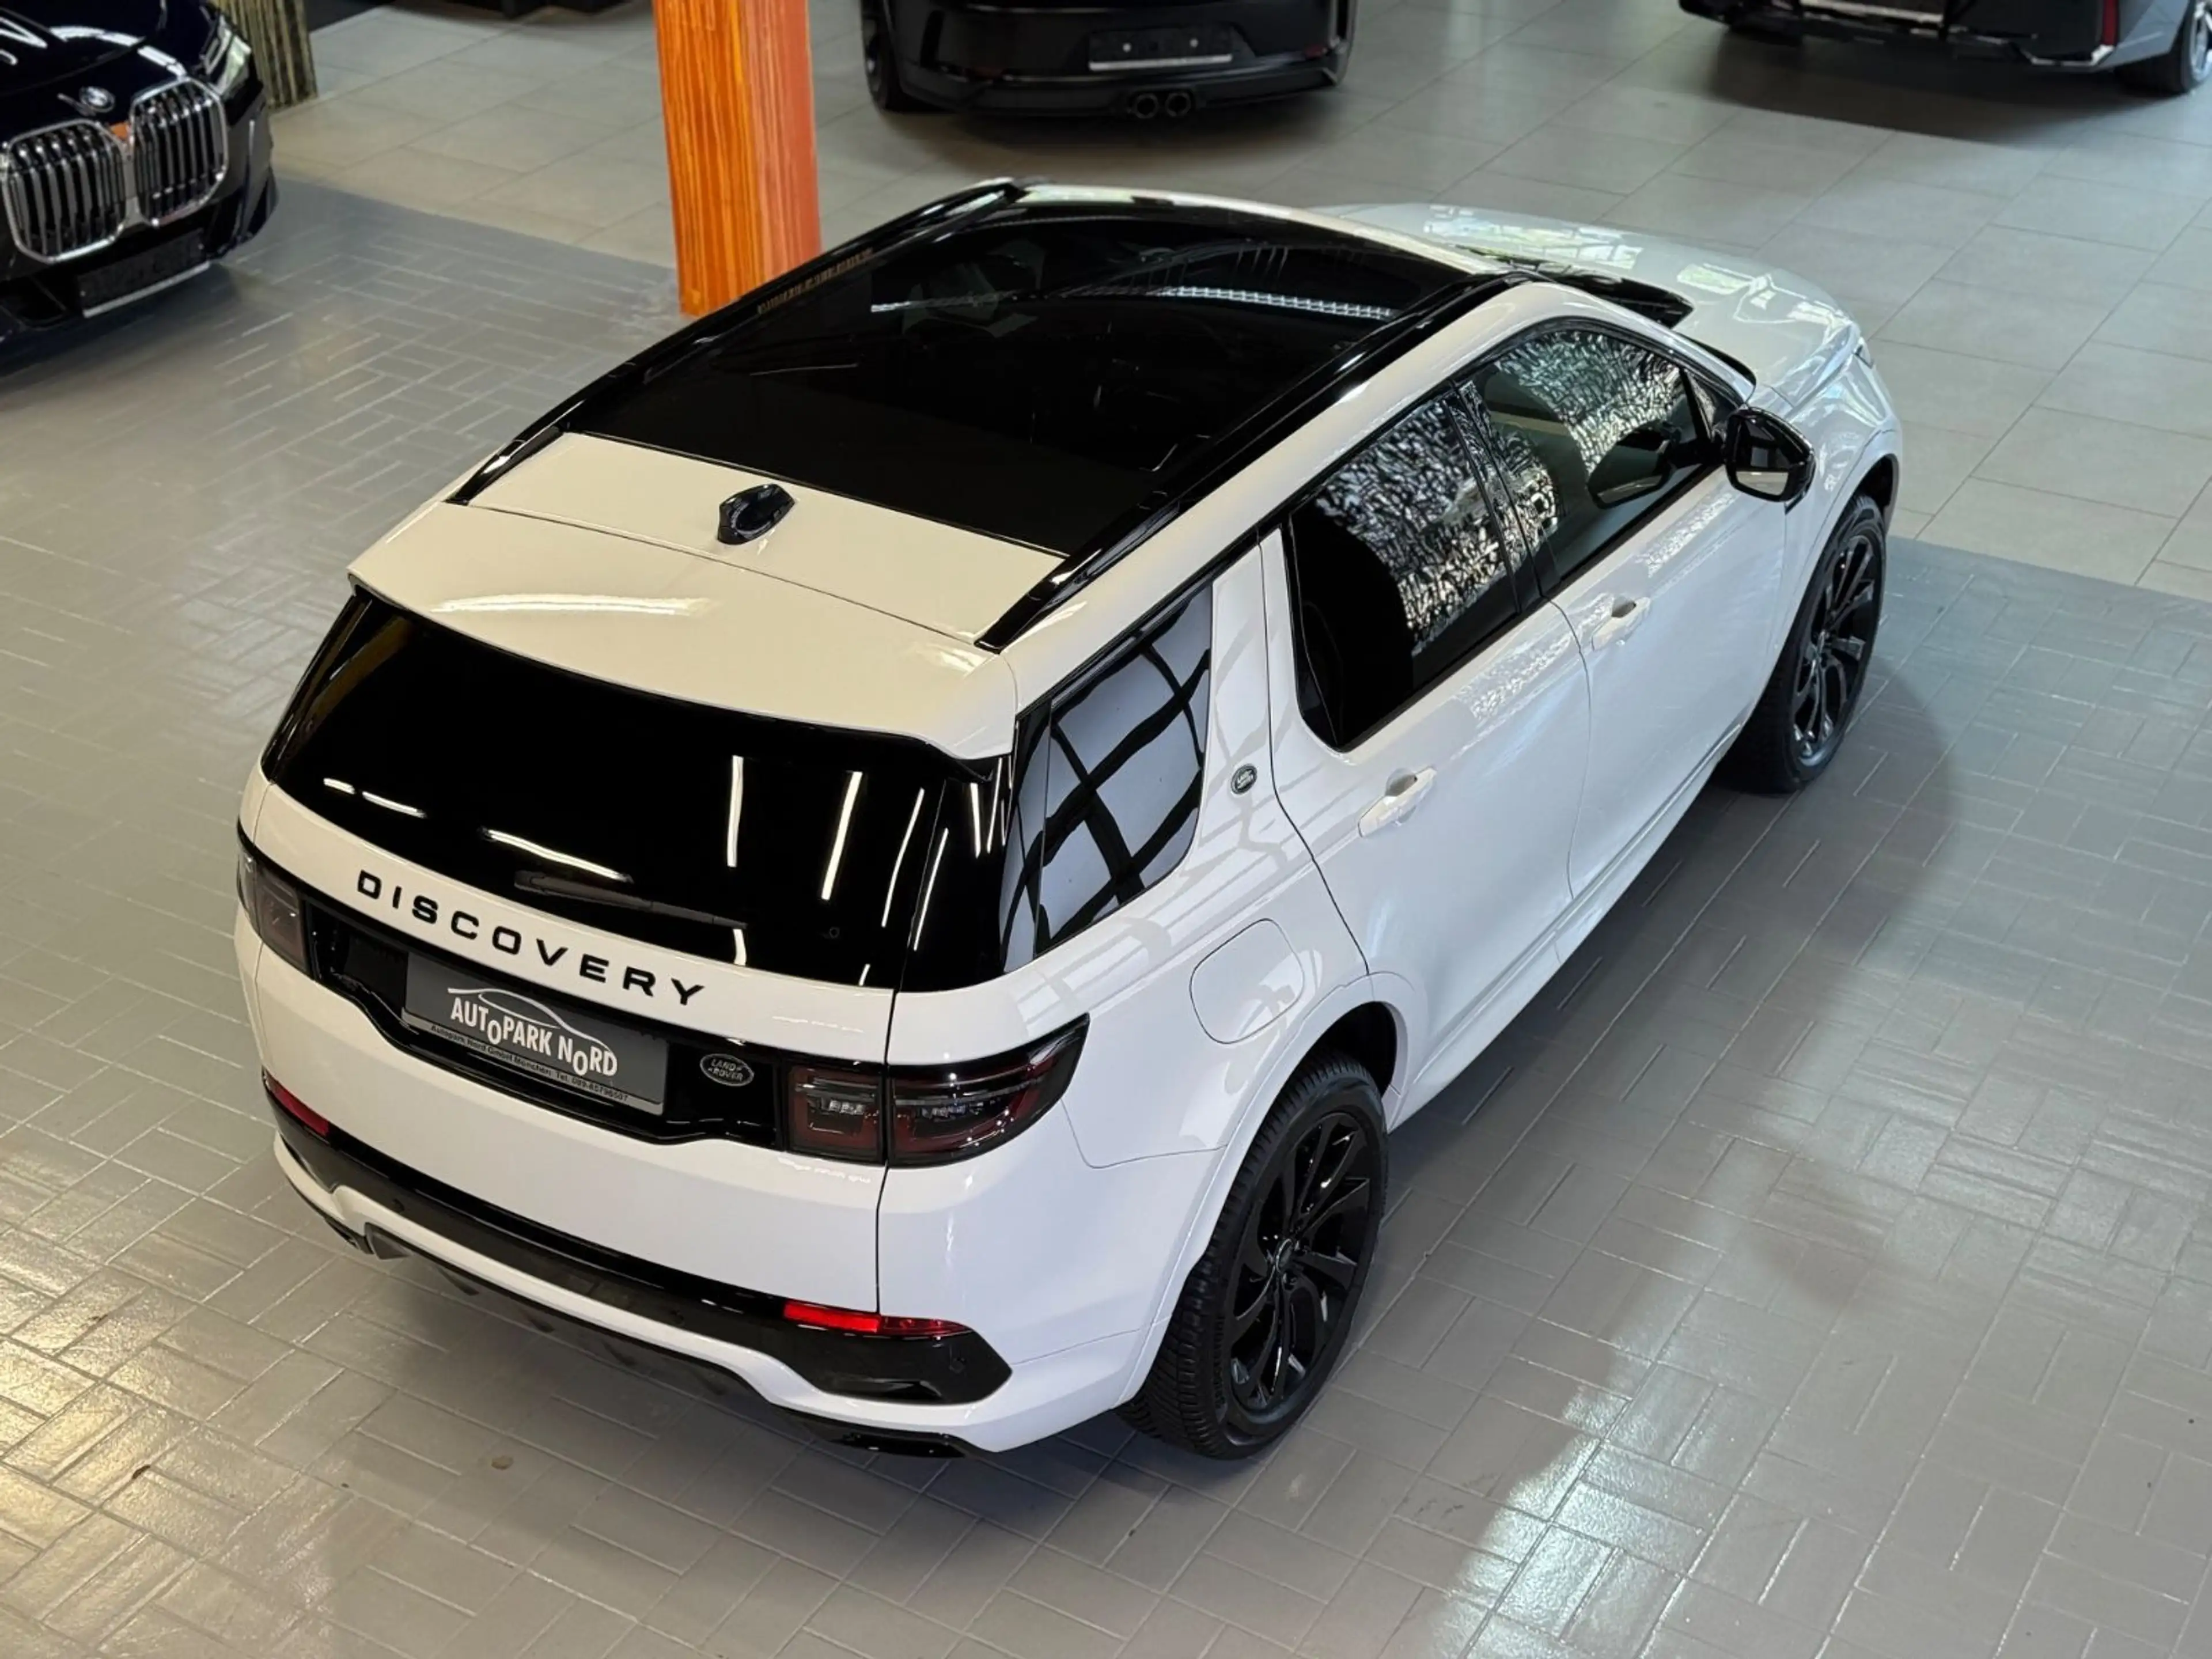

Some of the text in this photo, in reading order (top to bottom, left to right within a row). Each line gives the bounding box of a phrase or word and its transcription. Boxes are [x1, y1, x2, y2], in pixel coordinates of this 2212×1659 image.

[357, 869, 704, 1005] DISCOVERY
[450, 997, 618, 1077] AUTOPARK NORD
[711, 1059, 736, 1071] LAND
[713, 1067, 743, 1082] ROVER
